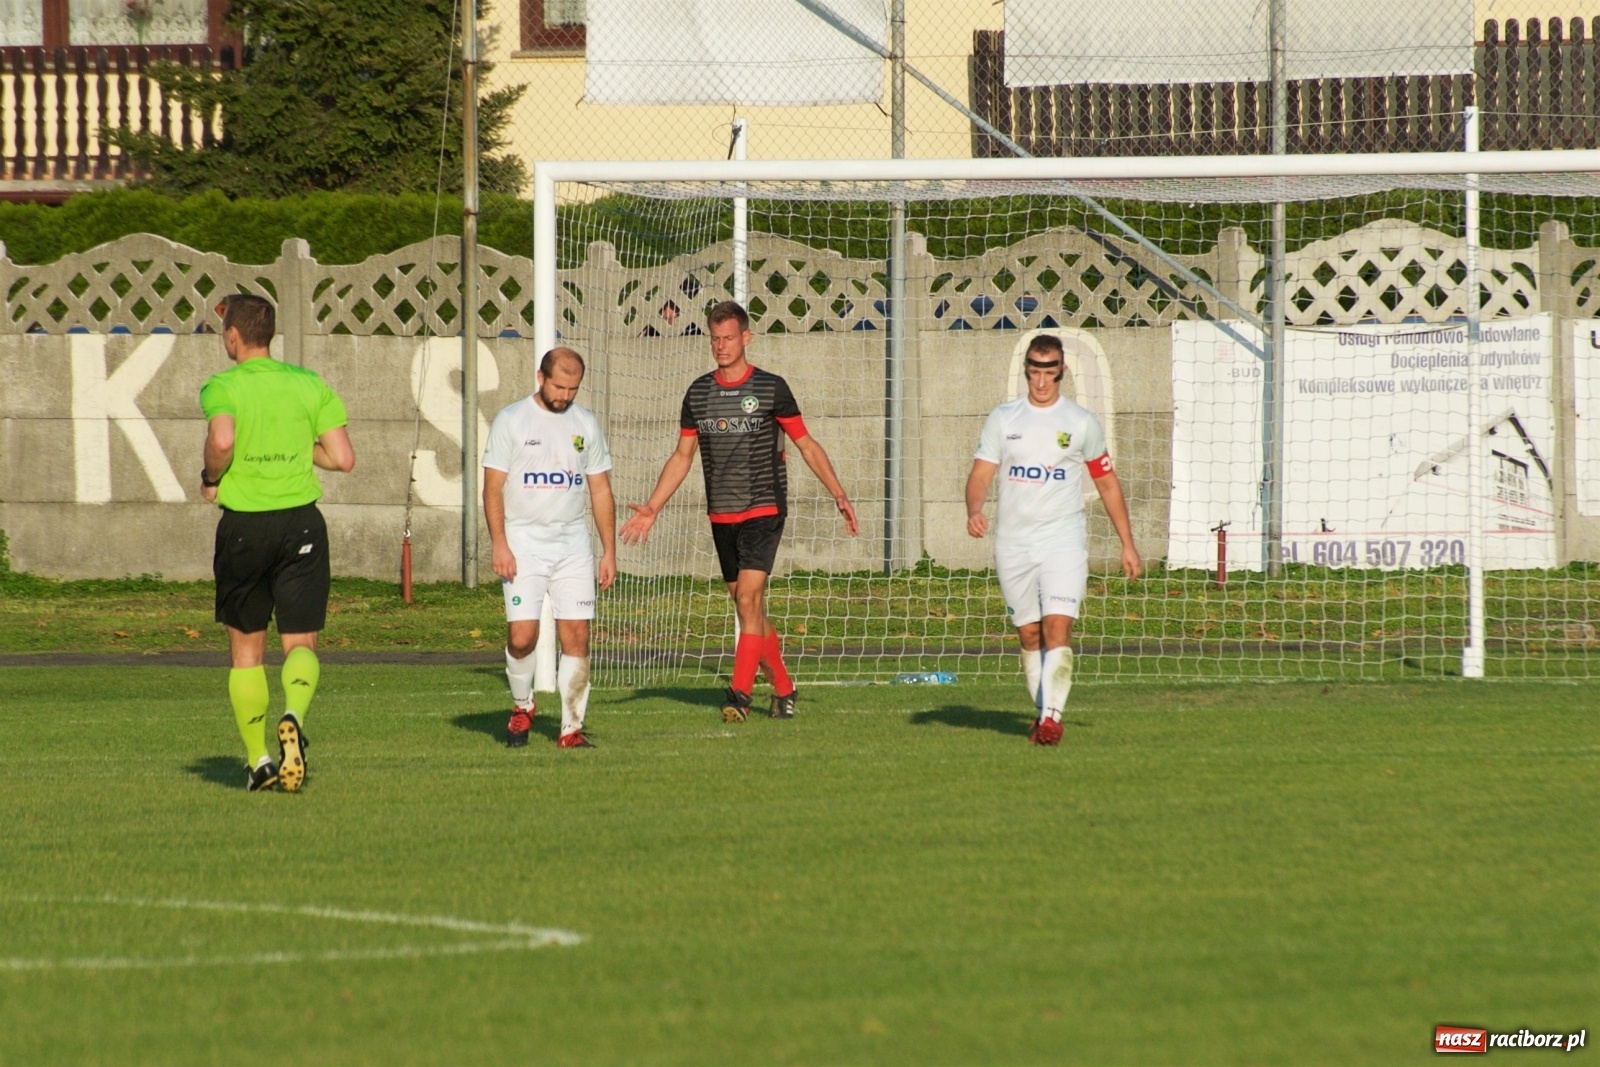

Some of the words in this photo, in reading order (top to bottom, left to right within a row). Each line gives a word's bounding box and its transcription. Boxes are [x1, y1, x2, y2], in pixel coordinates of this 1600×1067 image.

[1390, 351, 1469, 371] Docieplenia
[1479, 349, 1541, 368] udynków
[1298, 377, 1396, 396] Kompleksowe
[1400, 374, 1489, 395] wykończea
[71, 332, 187, 505] K
[409, 335, 500, 513] S
[523, 468, 584, 492] moya
[1008, 463, 1066, 484] moya
[1281, 541, 1298, 563] el
[1313, 540, 1358, 567] 604
[1366, 540, 1412, 567] 507
[1420, 539, 1465, 566] 320
